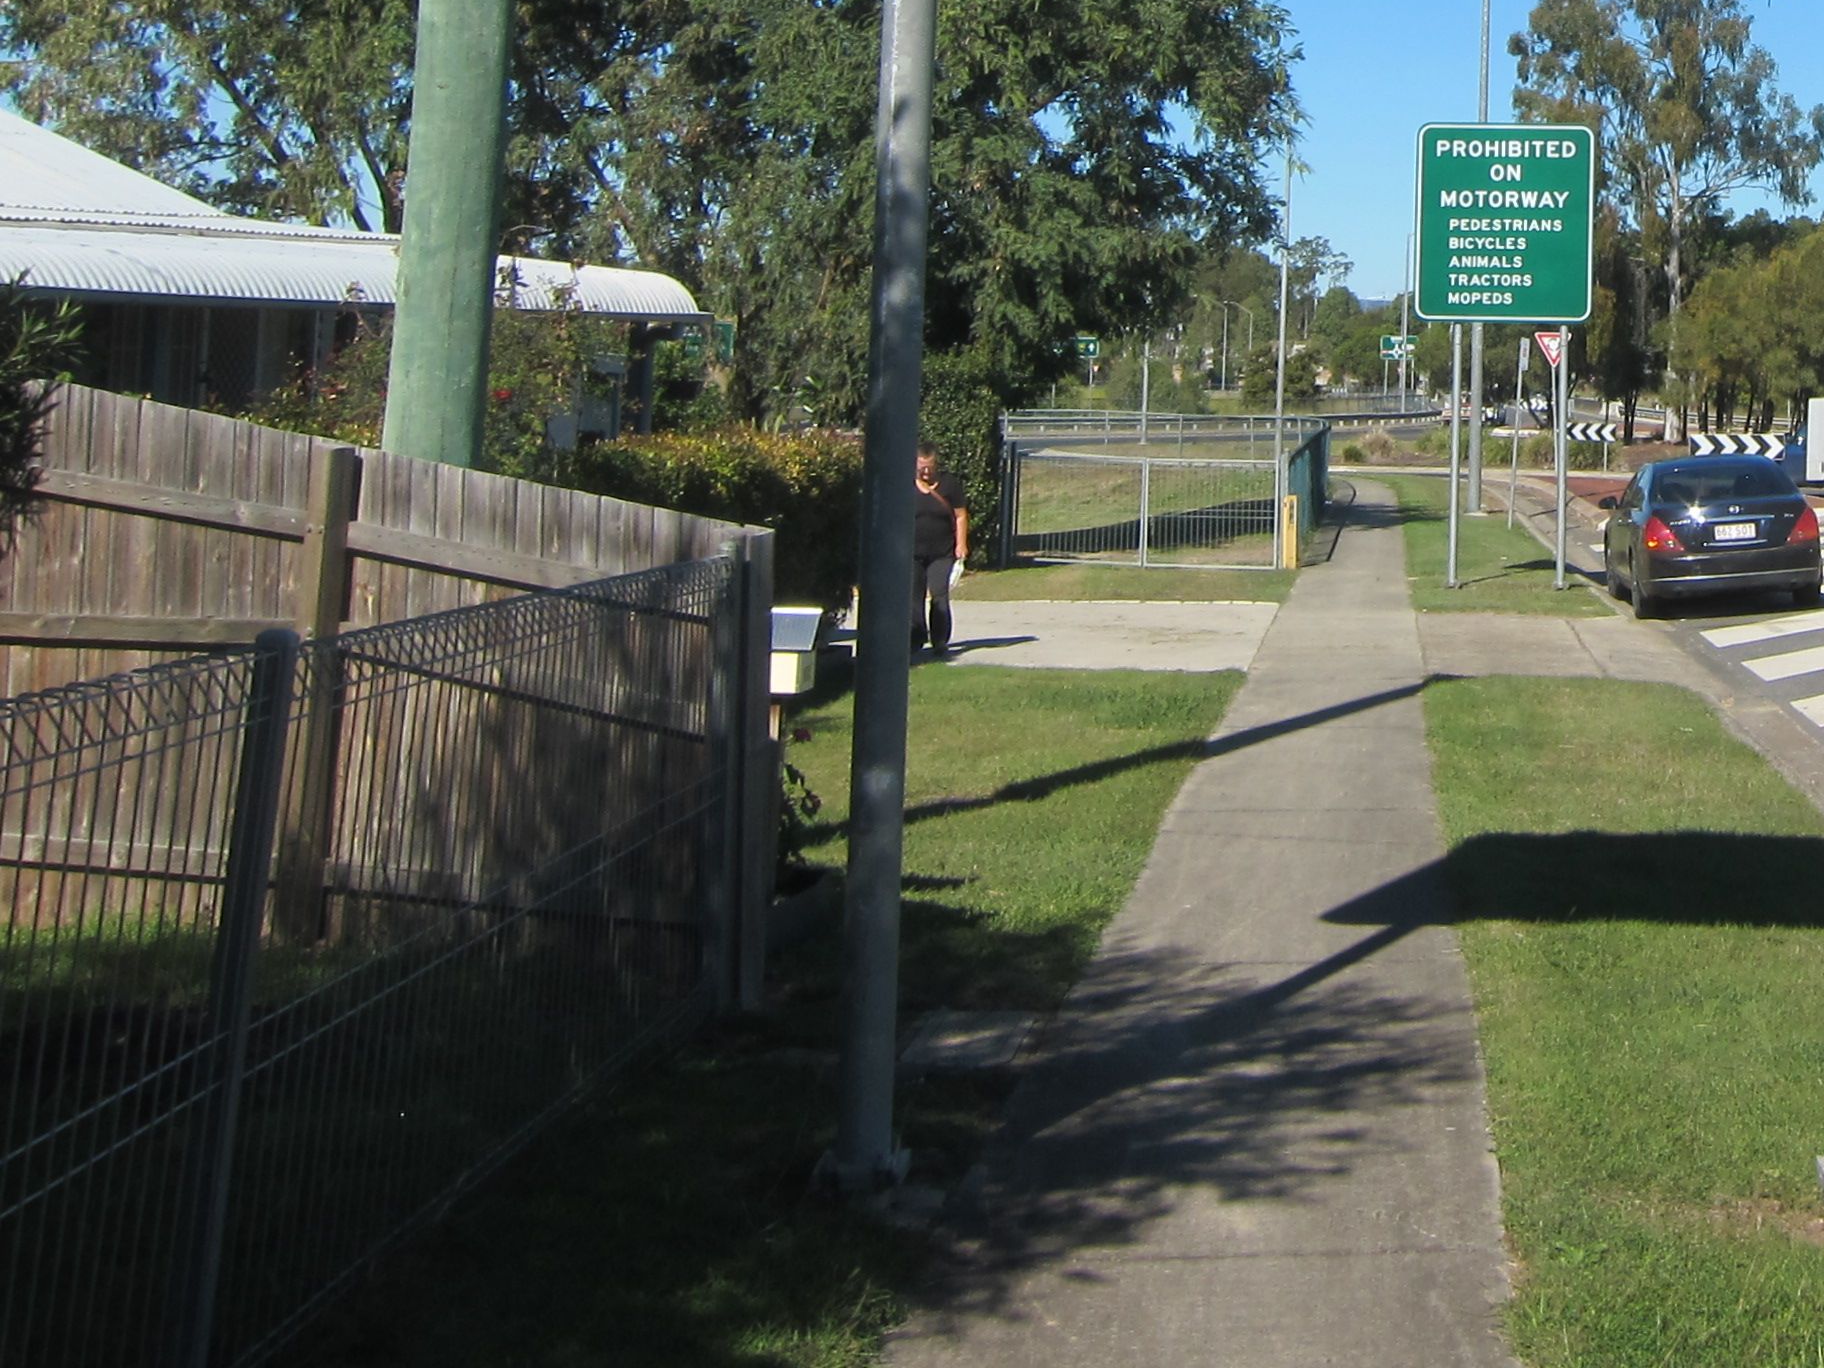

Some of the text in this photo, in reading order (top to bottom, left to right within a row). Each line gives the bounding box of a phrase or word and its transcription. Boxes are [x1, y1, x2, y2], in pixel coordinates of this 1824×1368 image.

[1436, 139, 1577, 159] PROHIBITED
[1489, 164, 1522, 182] ON
[1440, 190, 1570, 209] MOTORWAY
[1449, 218, 1563, 232] PEDESTRIANS
[1448, 236, 1527, 250] BICYCLES
[1448, 255, 1523, 268] ANIMALS
[1448, 273, 1533, 287] TRACTORS
[1447, 291, 1513, 305] MOPEDS
